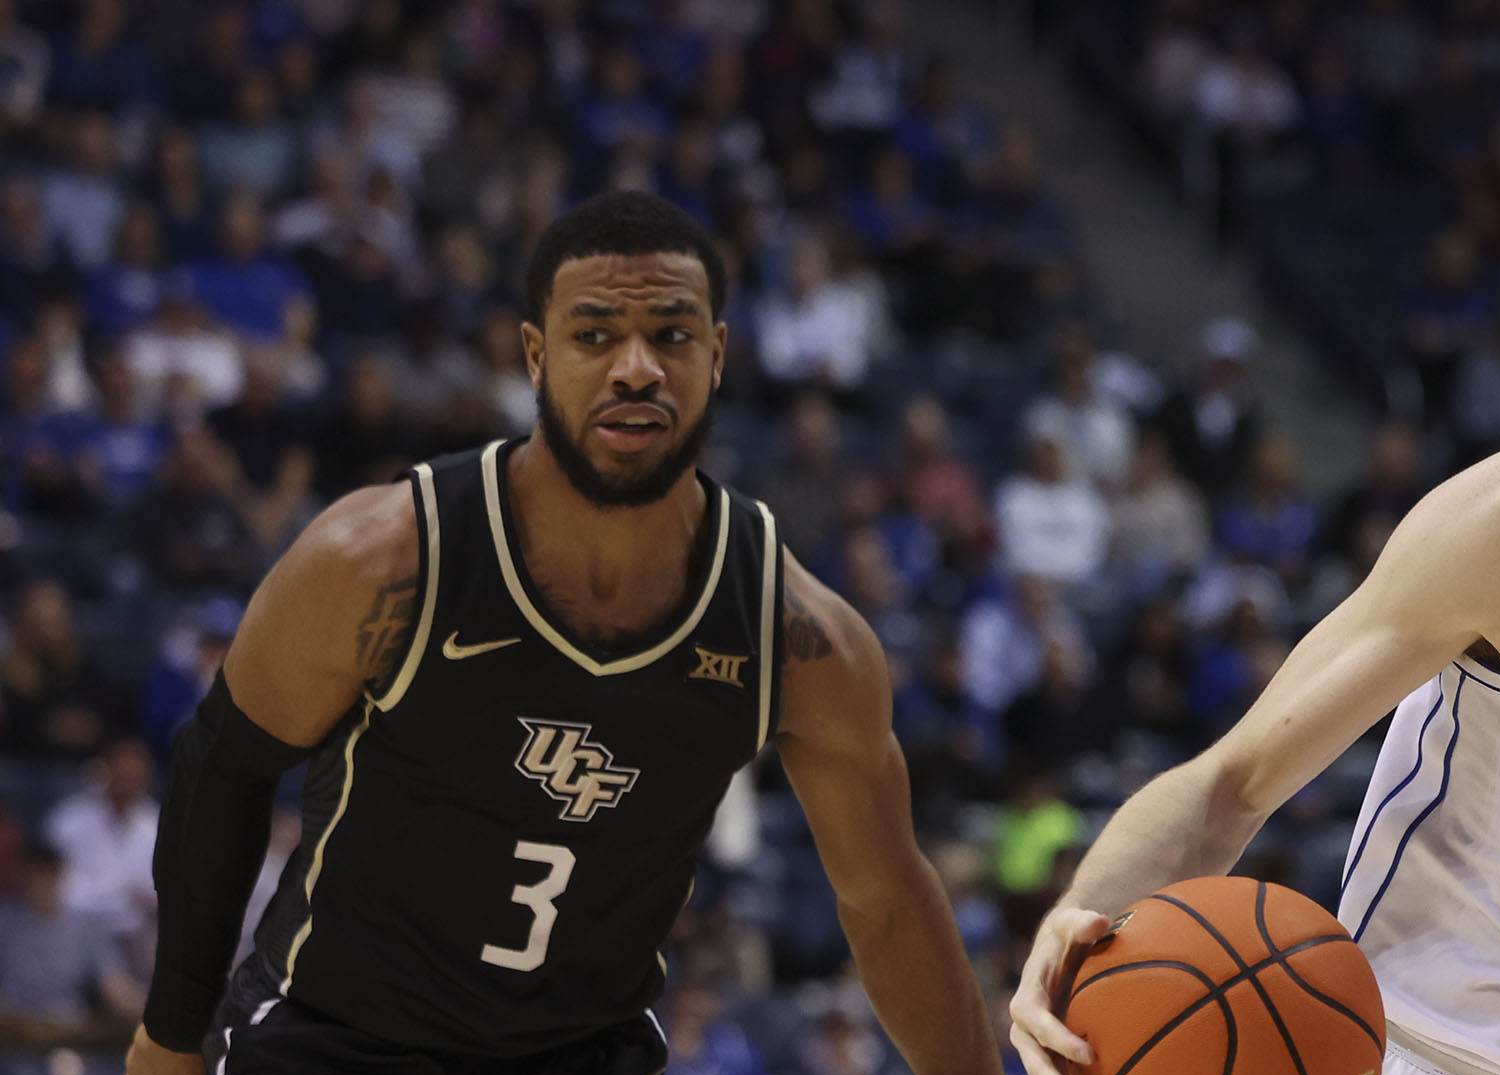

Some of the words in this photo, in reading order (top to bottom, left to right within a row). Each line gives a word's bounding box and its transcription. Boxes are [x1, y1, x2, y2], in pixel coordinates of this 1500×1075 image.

[688, 646, 749, 689] XII
[513, 716, 640, 823] UCF
[480, 839, 577, 972] 3
